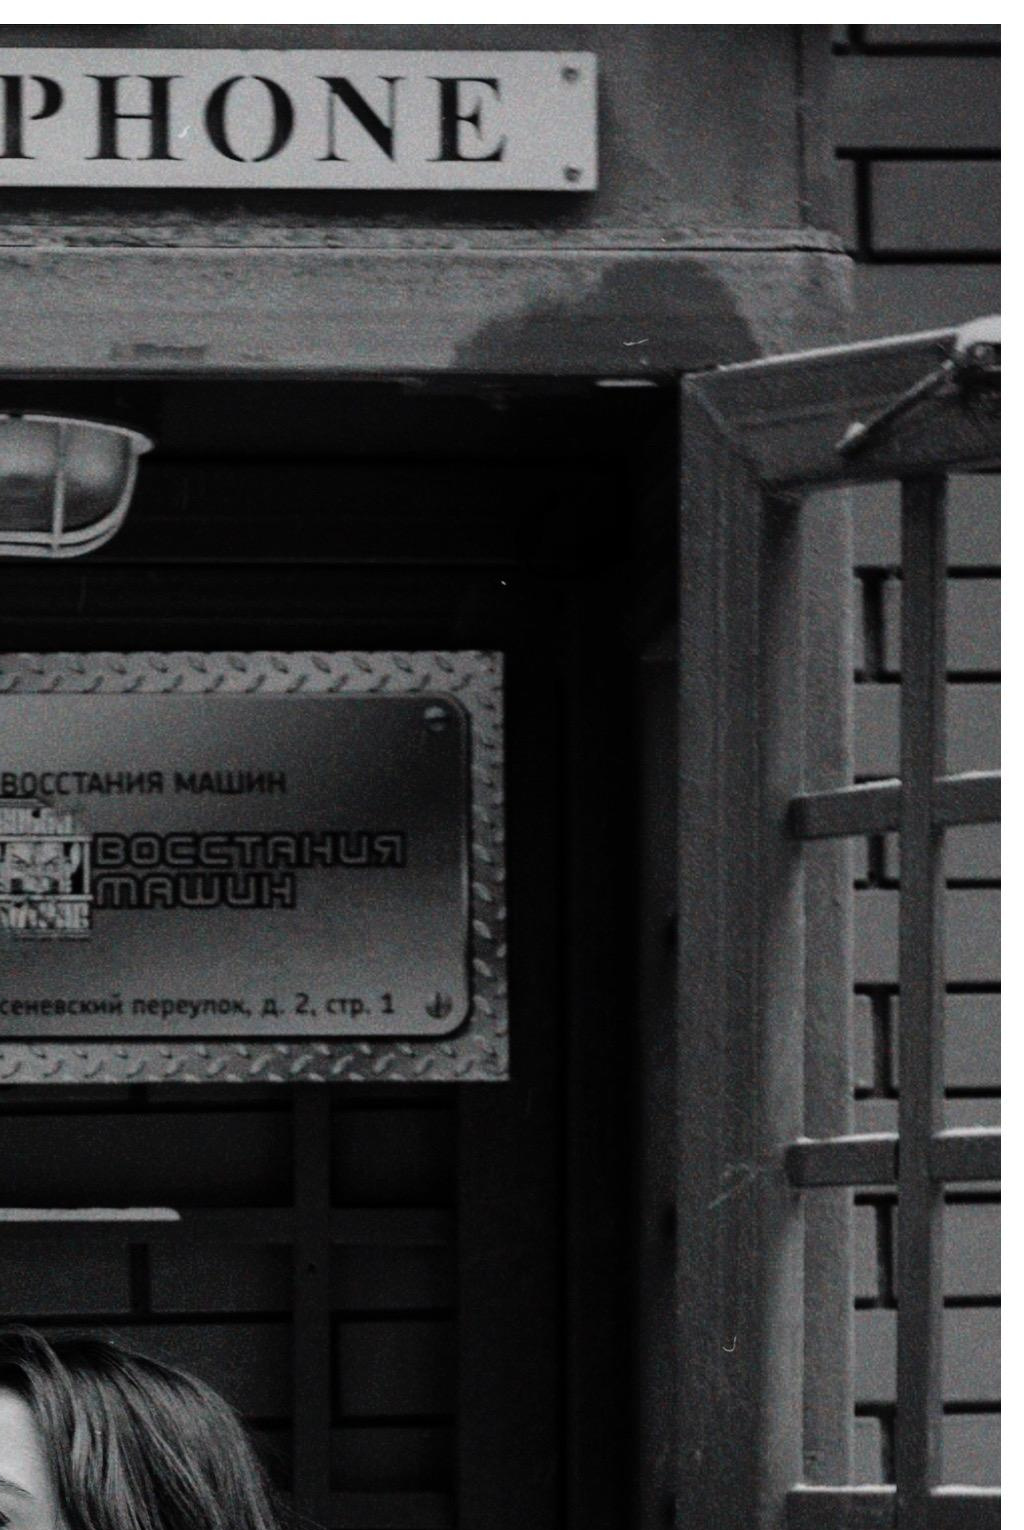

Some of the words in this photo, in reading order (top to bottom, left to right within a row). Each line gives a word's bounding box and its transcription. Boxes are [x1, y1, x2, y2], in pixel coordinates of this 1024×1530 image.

[0, 772, 163, 797] ВОССТАНИЯ
[175, 772, 288, 797] МАШИН
[91, 831, 408, 870] ВОССТАНИЯ
[92, 872, 298, 911] МАШИН
[132, 998, 252, 1020] переулок,
[381, 993, 395, 1015] 1
